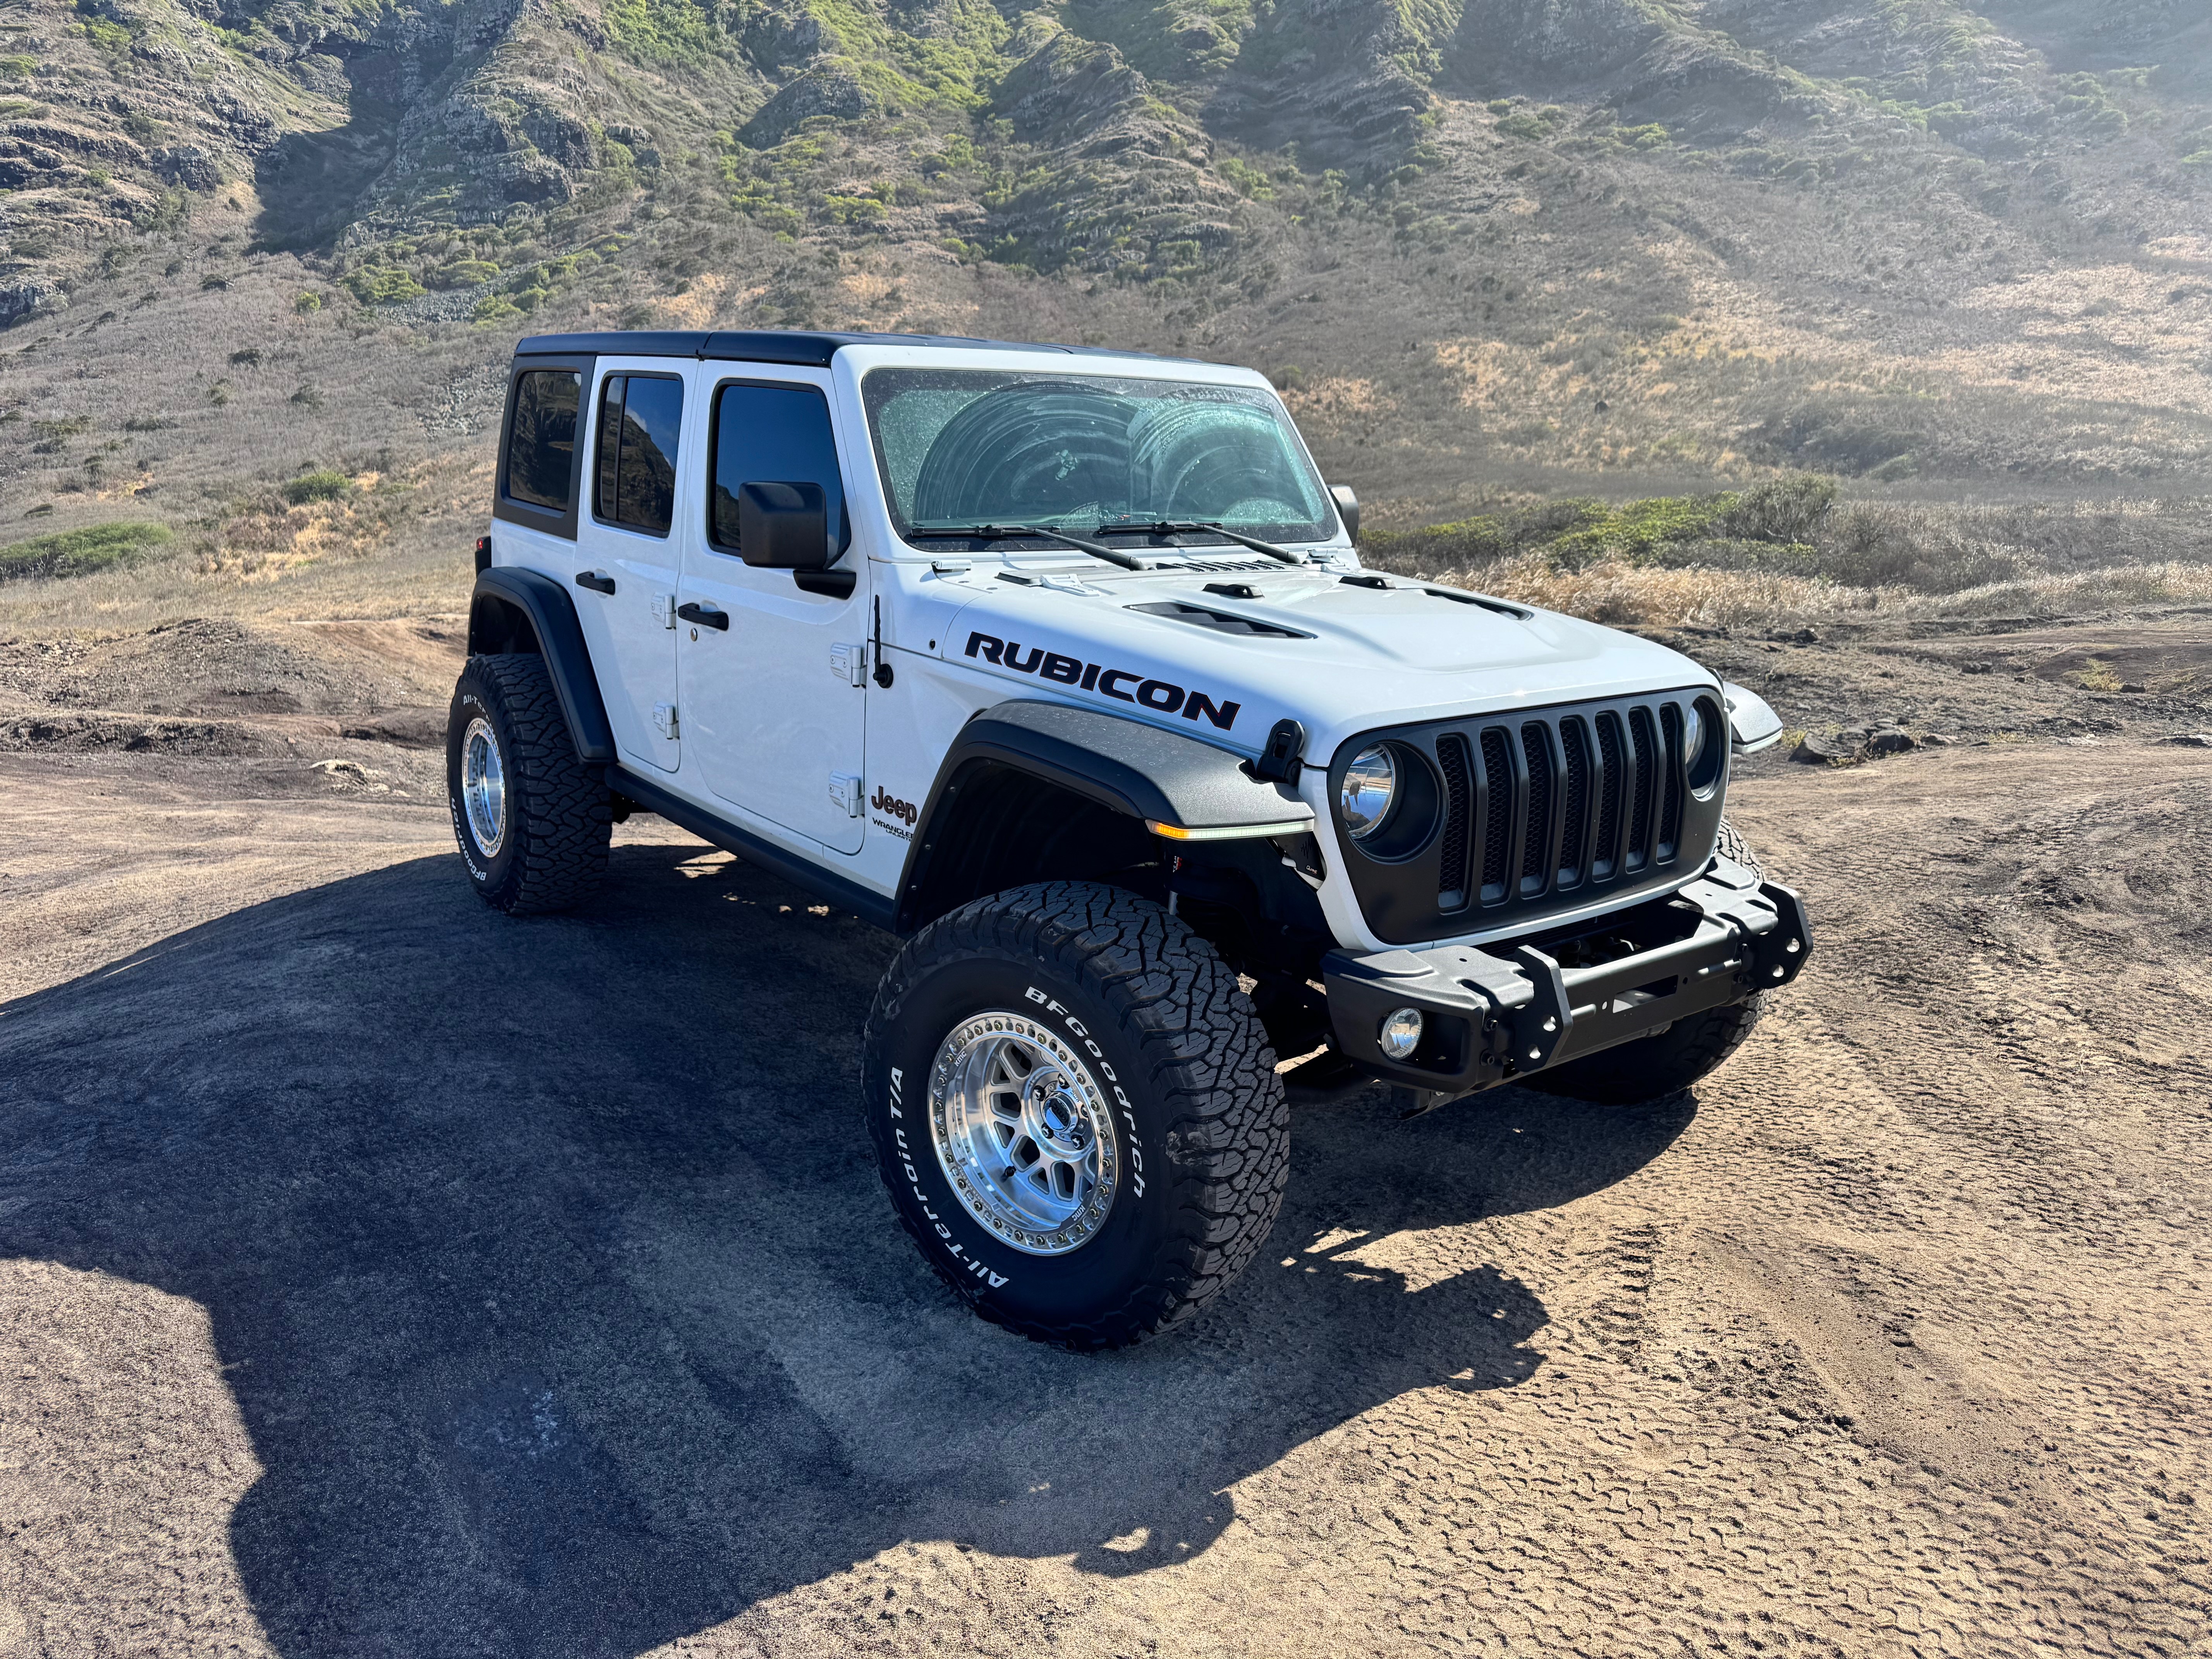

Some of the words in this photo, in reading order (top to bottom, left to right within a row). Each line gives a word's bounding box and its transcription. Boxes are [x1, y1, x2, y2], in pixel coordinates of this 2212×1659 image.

[965, 631, 1241, 731] RUBICON
[452, 797, 486, 881] BFGoodrich
[871, 785, 917, 827] Jeep
[890, 1067, 903, 1118] T/A
[1025, 986, 1145, 1198] BFGoodrich
[896, 1128, 1009, 1288] All-Terrain
